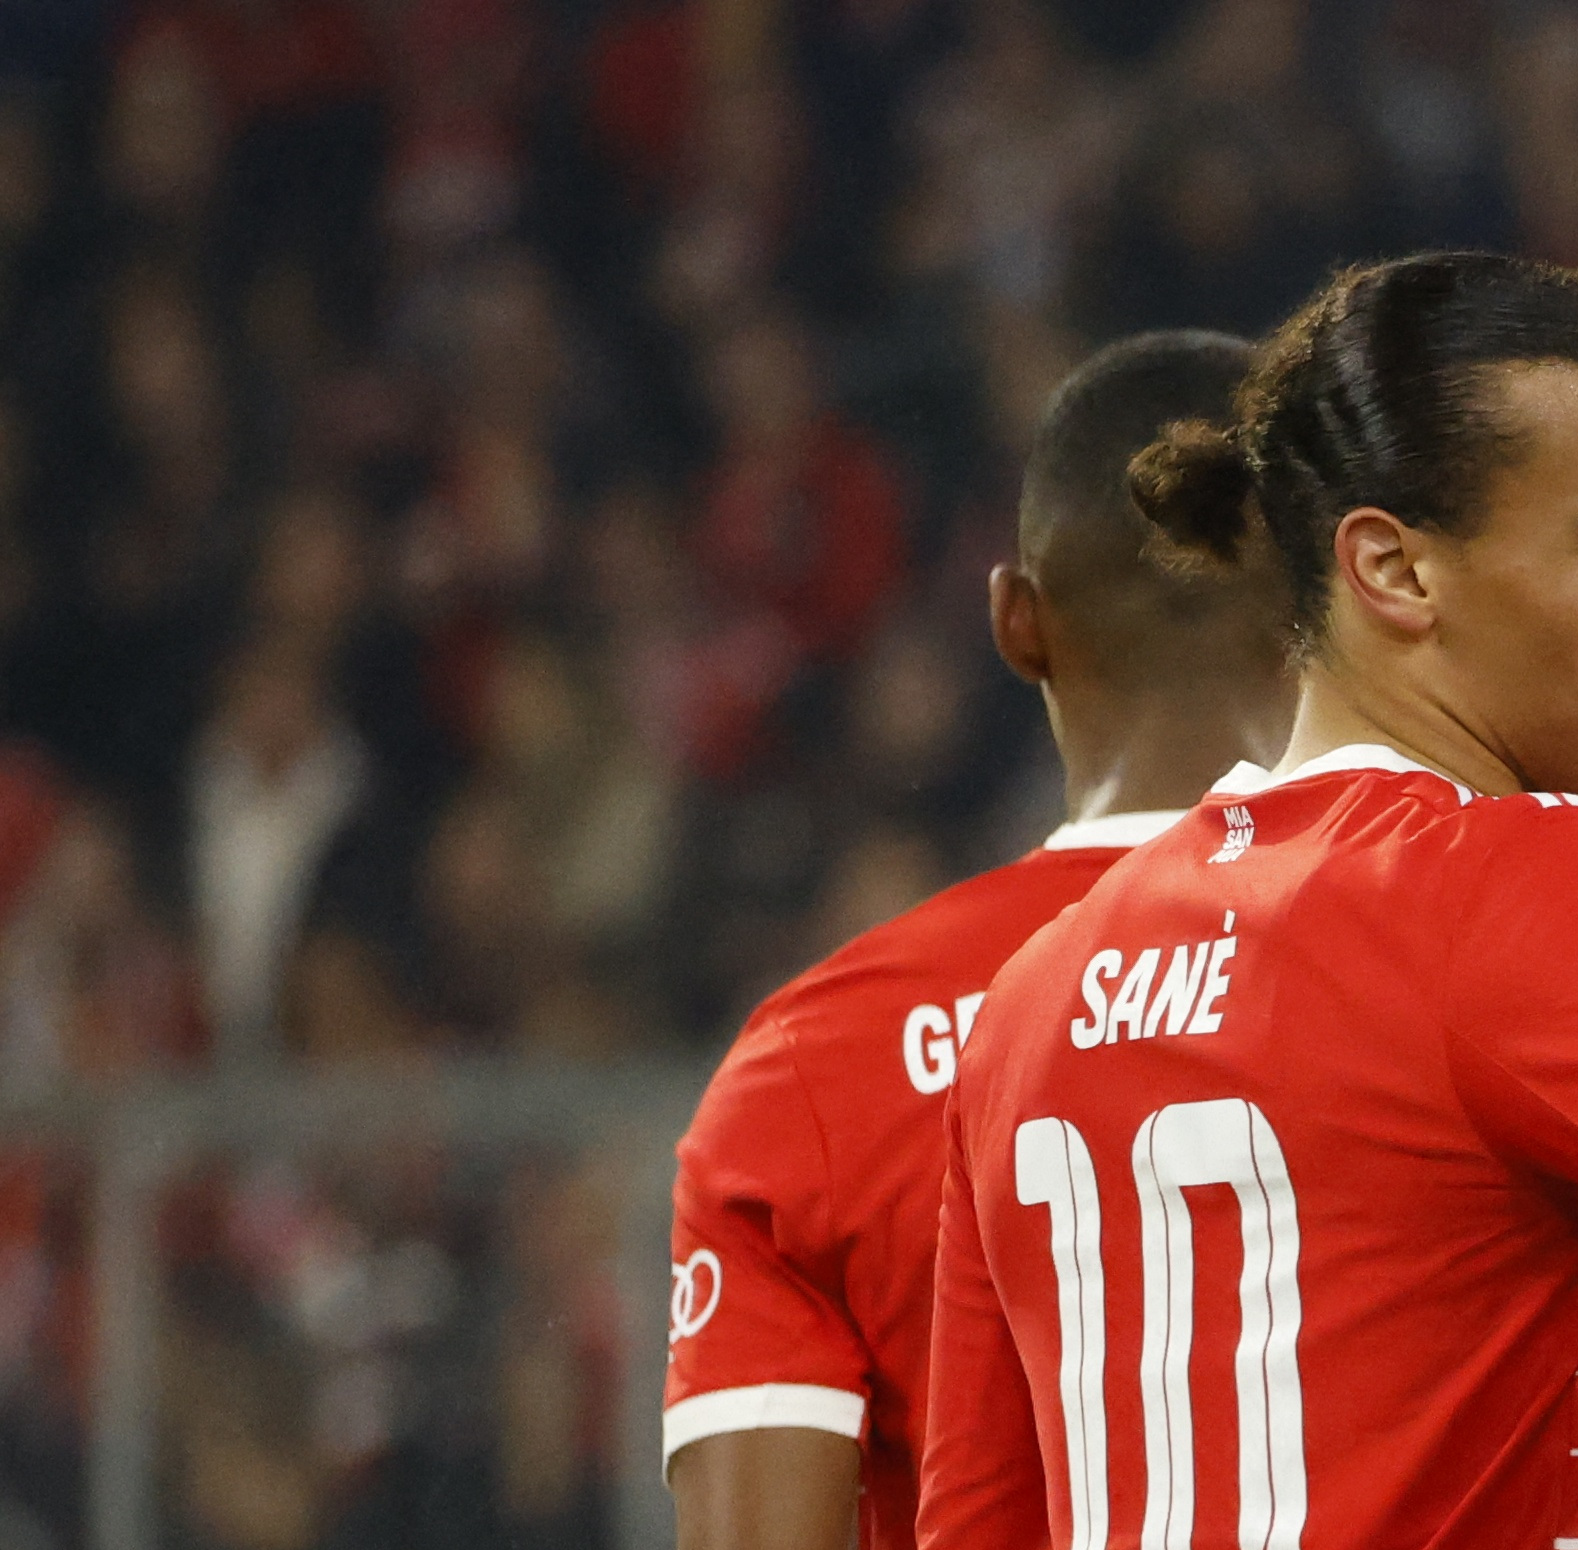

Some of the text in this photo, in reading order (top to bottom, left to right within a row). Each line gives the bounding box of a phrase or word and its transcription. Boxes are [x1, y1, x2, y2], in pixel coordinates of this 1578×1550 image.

[1223, 805, 1255, 828] MIA
[1222, 827, 1255, 850] SAN
[1070, 908, 1238, 1050] SANÉ
